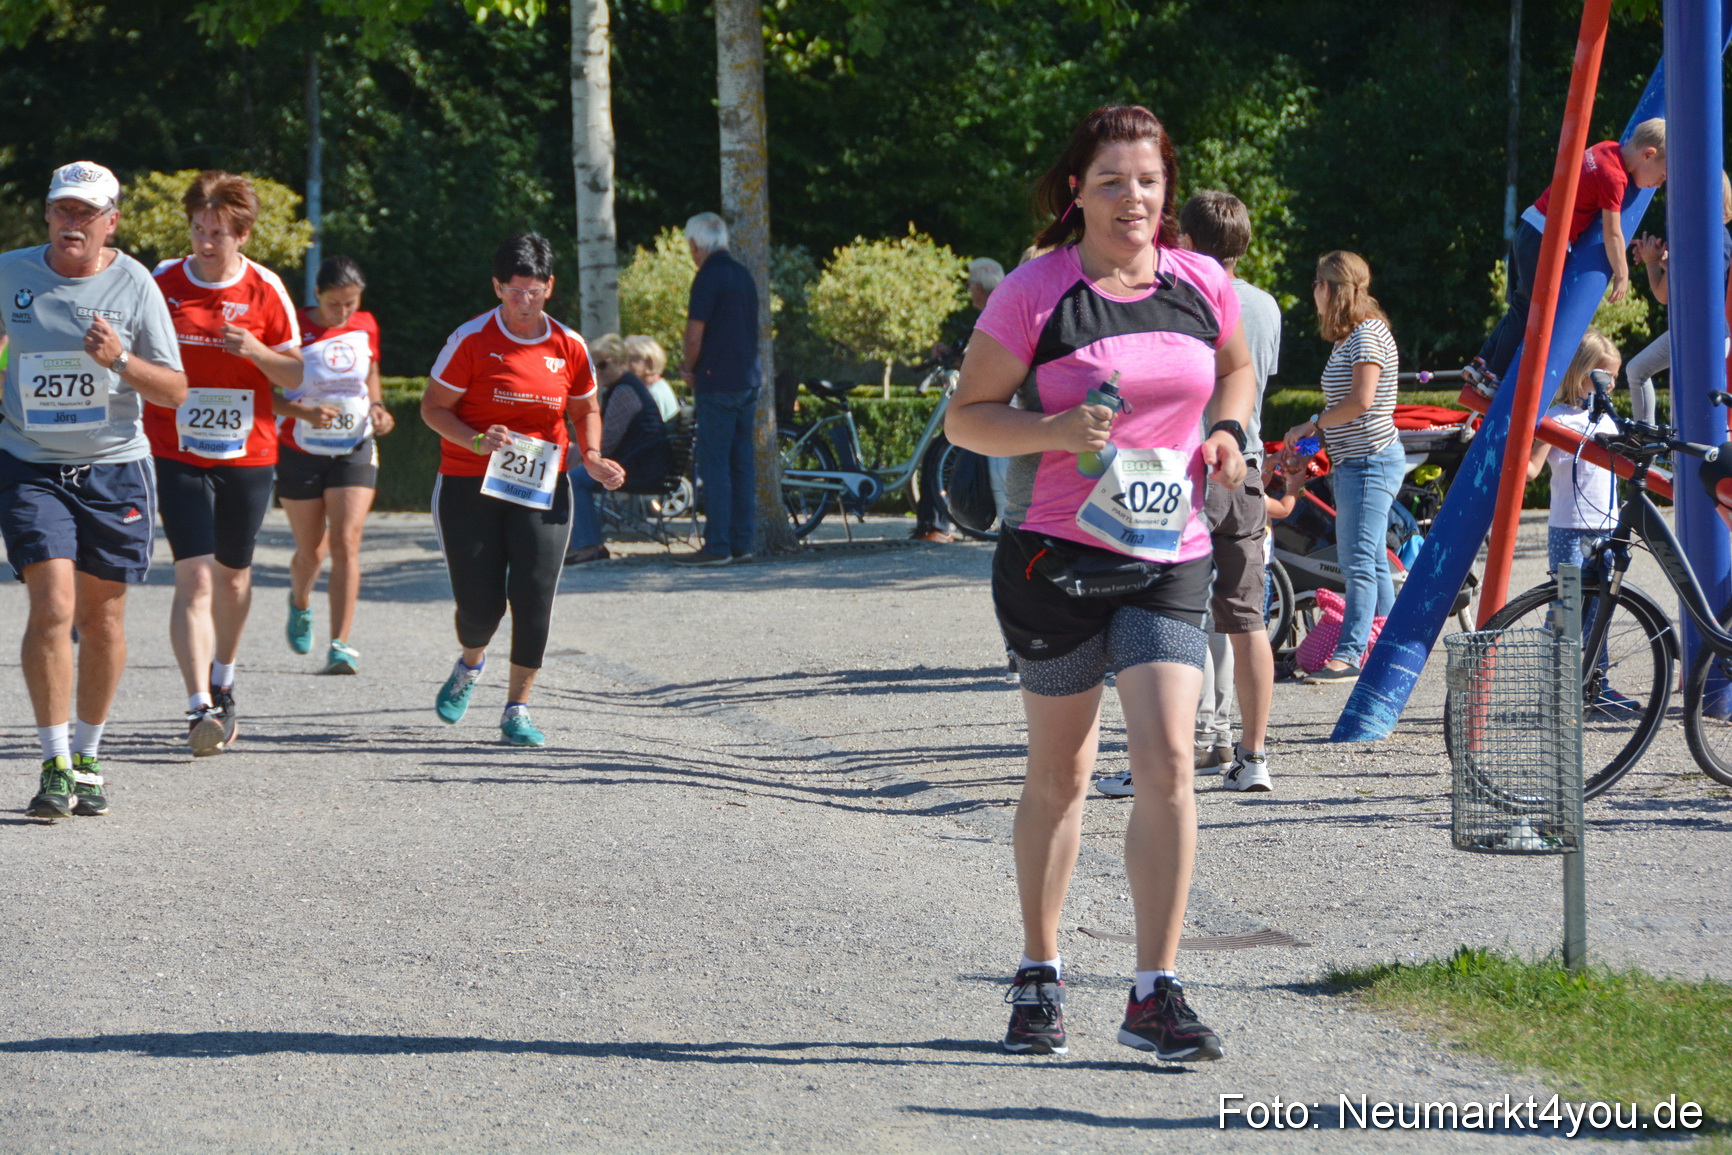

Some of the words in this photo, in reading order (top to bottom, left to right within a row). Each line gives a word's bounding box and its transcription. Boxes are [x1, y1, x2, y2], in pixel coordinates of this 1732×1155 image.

[76, 307, 122, 321] BOCK
[43, 358, 81, 368] BOCK
[33, 373, 95, 398] 2578
[53, 412, 78, 423] Jörg
[188, 407, 242, 430] 2243
[500, 450, 547, 481] 2311
[1122, 459, 1171, 471] BOC
[505, 484, 533, 499] Margit
[1111, 507, 1133, 524] PARTL
[1133, 517, 1160, 525] Neumarkt
[1120, 528, 1145, 544] Tina
[1320, 562, 1342, 574] THUL
